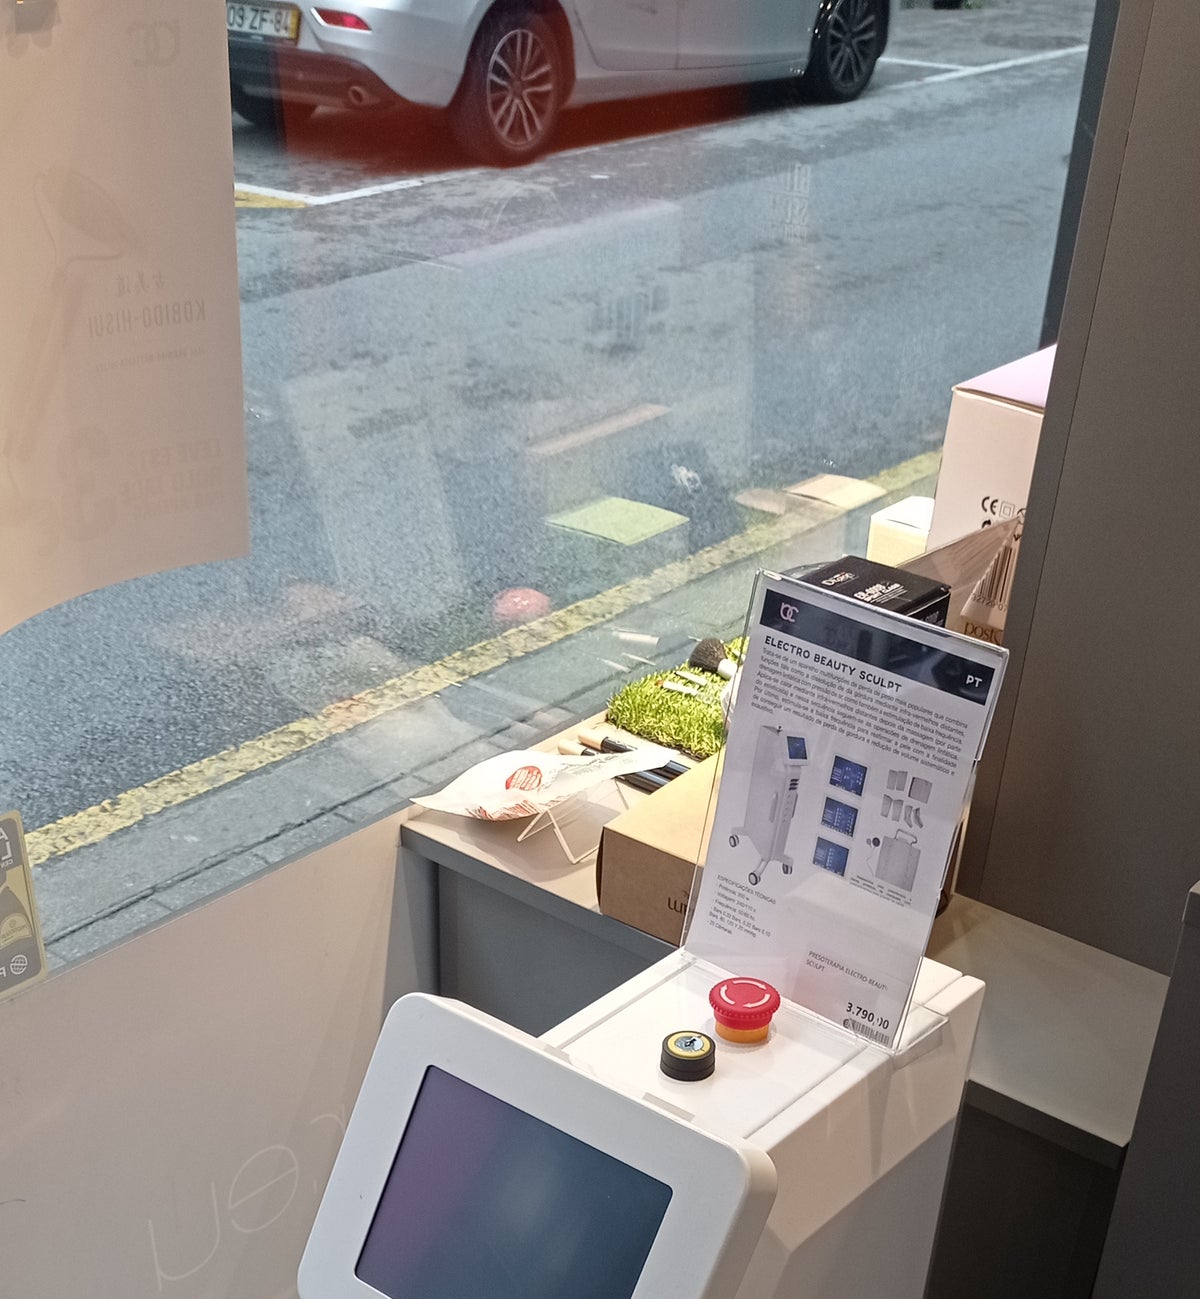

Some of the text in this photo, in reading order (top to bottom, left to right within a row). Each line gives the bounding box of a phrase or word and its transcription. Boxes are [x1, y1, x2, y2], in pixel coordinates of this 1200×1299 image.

[764, 635, 901, 693] ELECTRO BEAUTY SCULPT
[965, 674, 982, 688] PT
